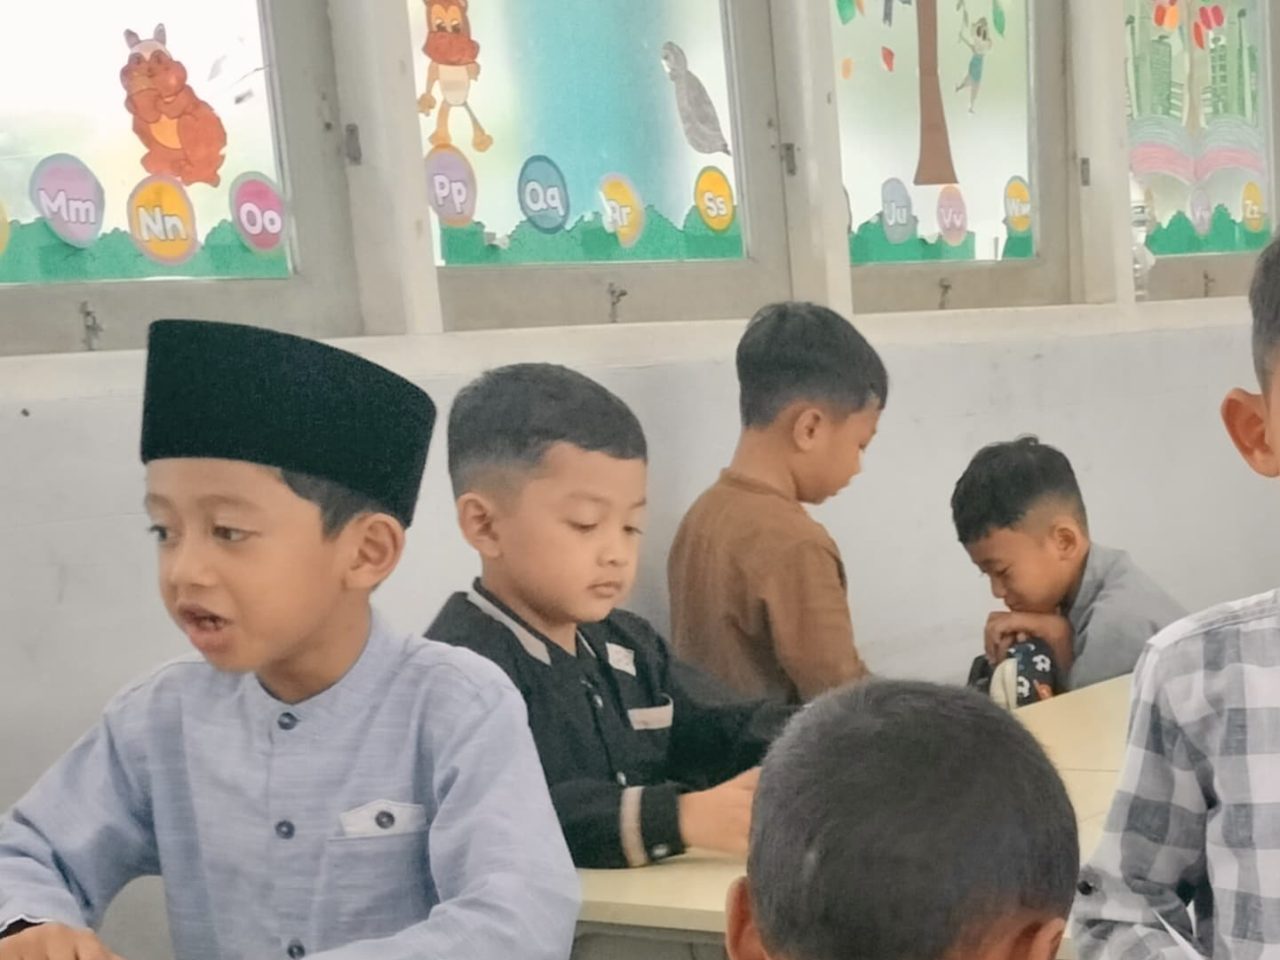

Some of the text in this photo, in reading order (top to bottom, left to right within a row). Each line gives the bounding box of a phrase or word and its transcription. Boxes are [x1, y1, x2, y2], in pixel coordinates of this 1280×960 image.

[38, 188, 96, 224] Mm
[433, 173, 467, 214] Pp
[524, 180, 565, 217] Qq
[703, 191, 729, 218] Ss
[137, 205, 188, 241] Nn
[239, 202, 283, 235] Oo
[939, 206, 965, 229] Vv
